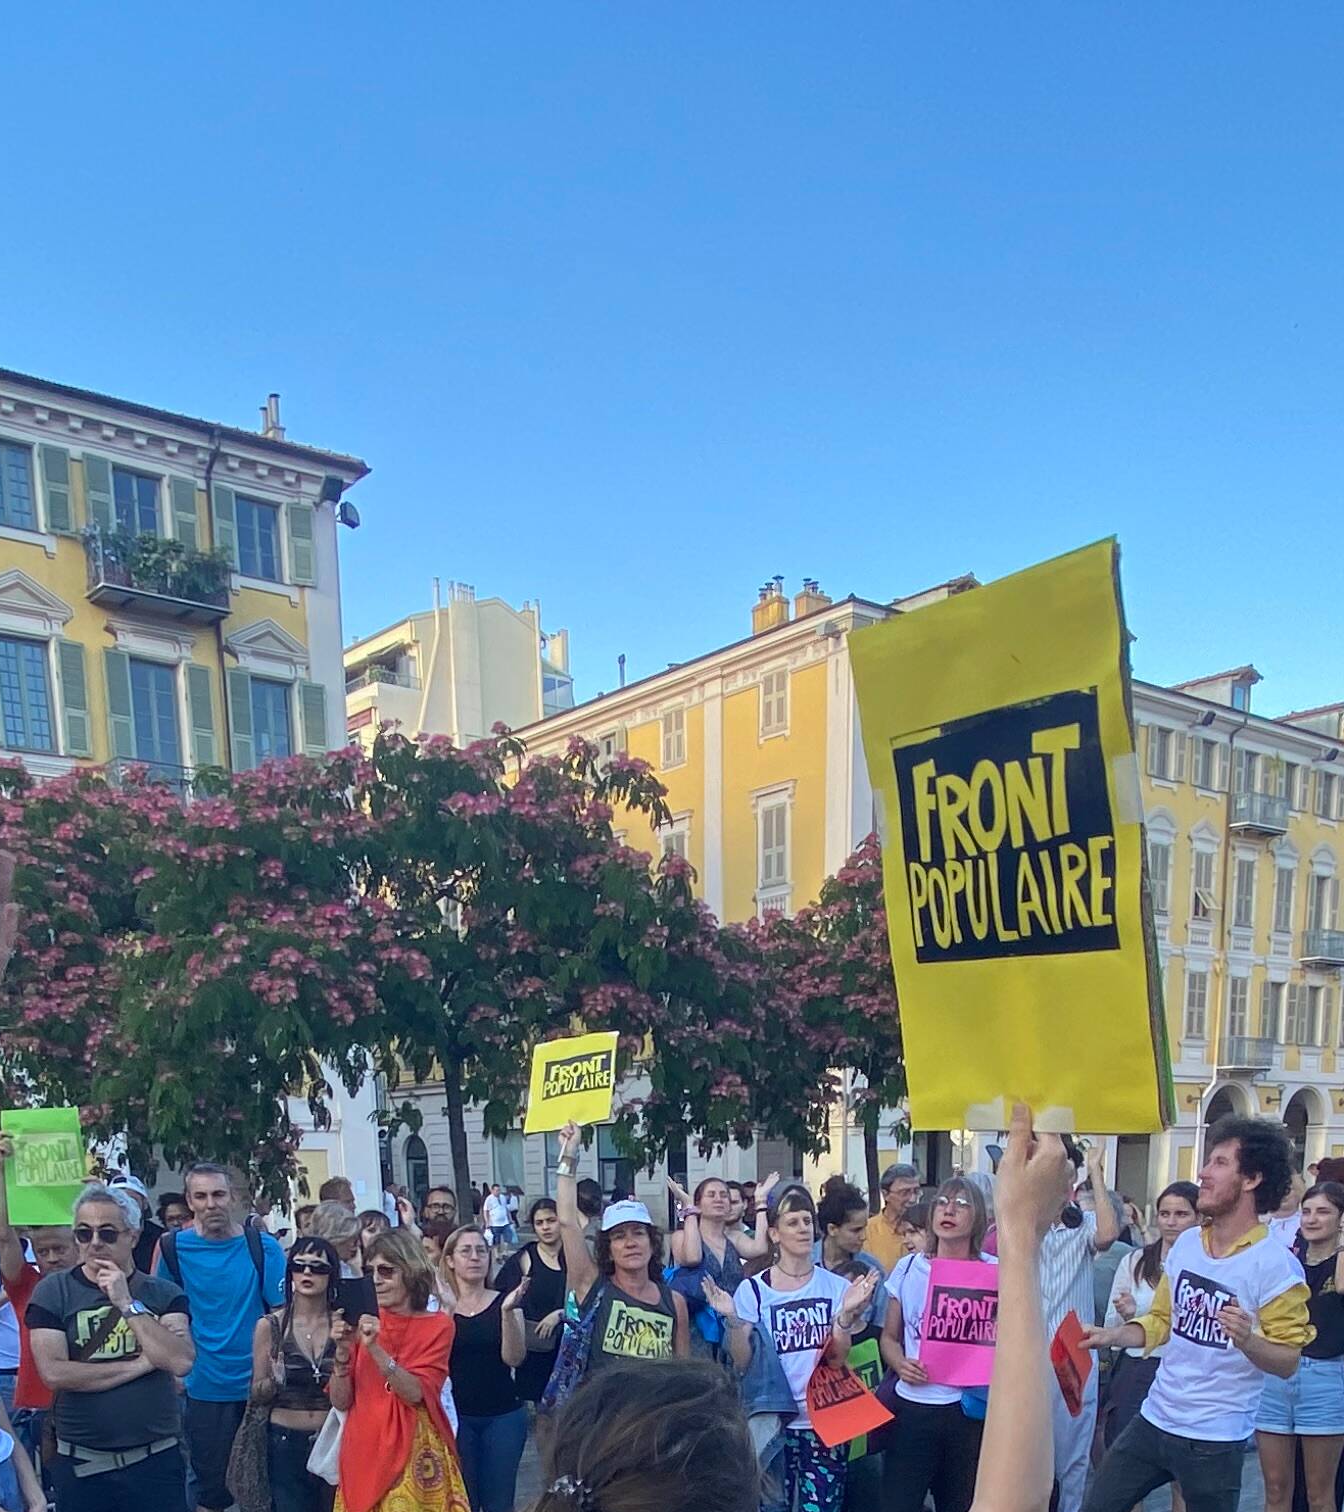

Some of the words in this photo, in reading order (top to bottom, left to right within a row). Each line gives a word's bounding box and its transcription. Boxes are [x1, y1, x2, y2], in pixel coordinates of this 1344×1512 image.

[912, 723, 1080, 864] FRONT
[909, 836, 1114, 949] POPULAIRE
[550, 1054, 607, 1082] FRONT
[543, 1070, 612, 1099] POPULAIRE
[16, 1139, 71, 1164] FRONT
[16, 1160, 83, 1184] POPULAIRE
[776, 1302, 828, 1333] FRONT
[937, 1292, 998, 1320] FRONT
[616, 1310, 667, 1339] FRONT
